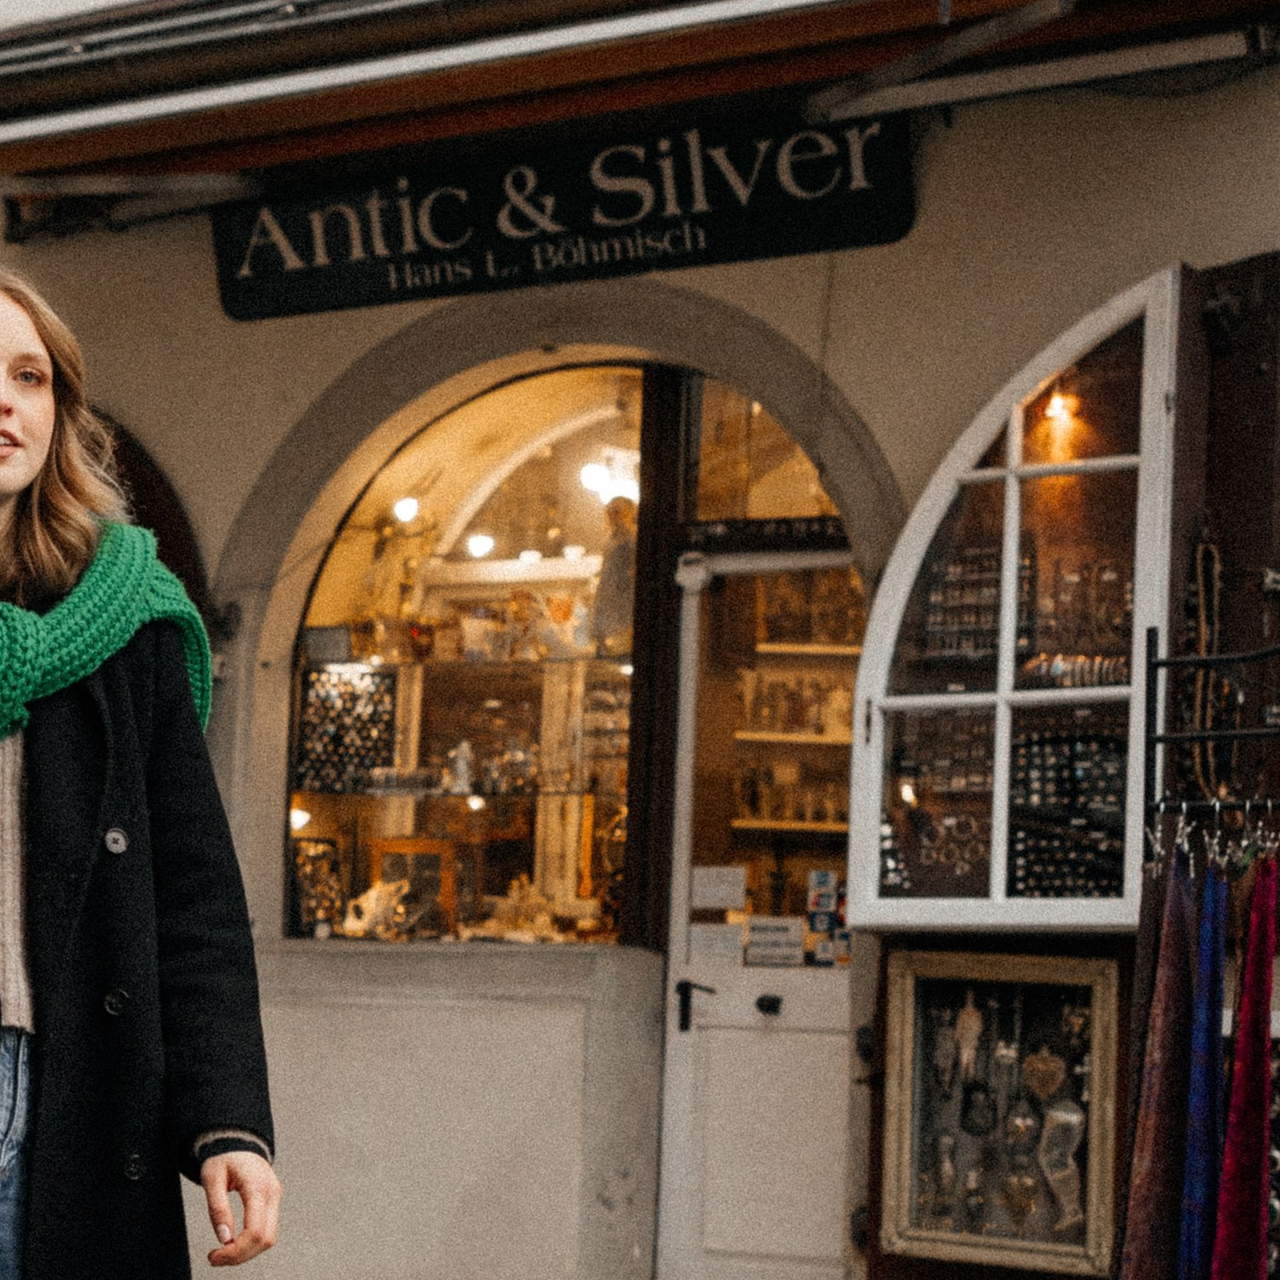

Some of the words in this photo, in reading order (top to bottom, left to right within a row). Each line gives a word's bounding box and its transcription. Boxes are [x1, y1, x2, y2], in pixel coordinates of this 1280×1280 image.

[237, 177, 475, 277] Antic
[497, 166, 564, 238] &
[589, 122, 881, 227] Silver
[387, 261, 473, 290] Hans
